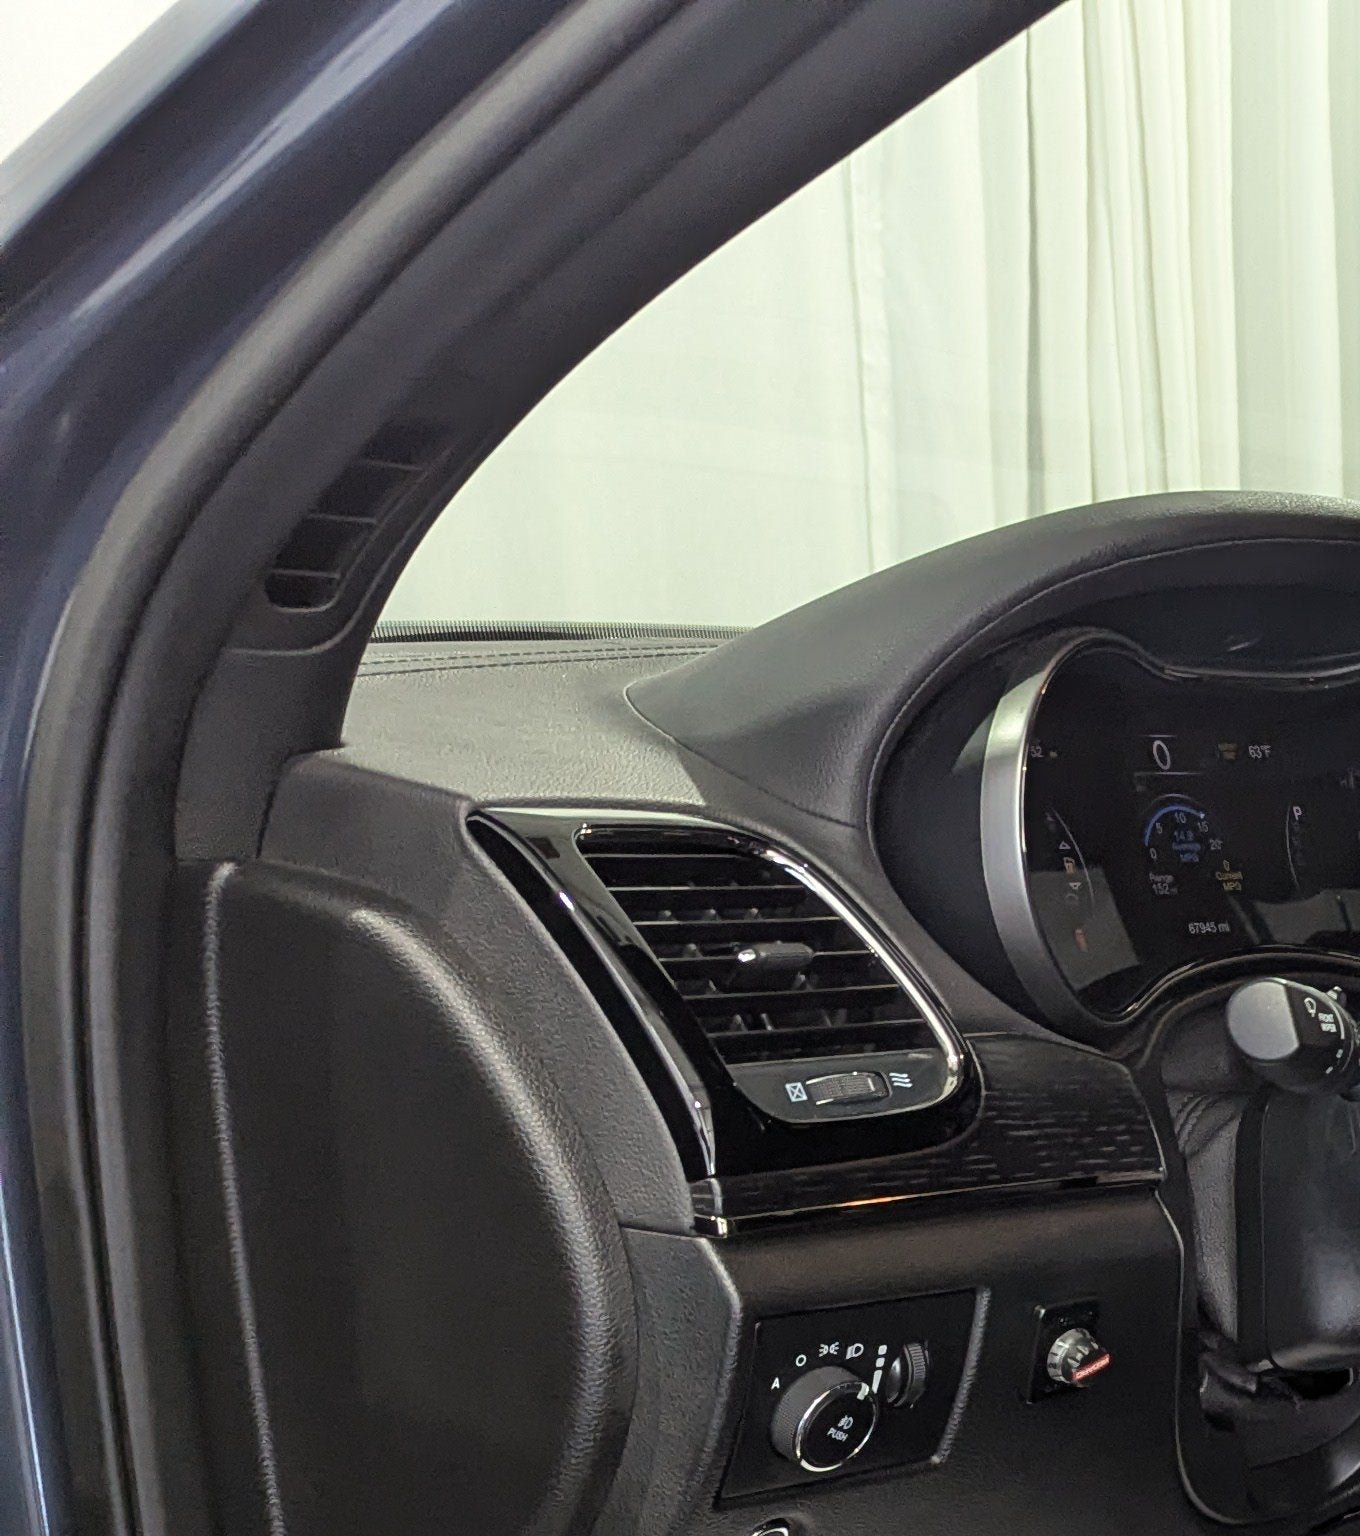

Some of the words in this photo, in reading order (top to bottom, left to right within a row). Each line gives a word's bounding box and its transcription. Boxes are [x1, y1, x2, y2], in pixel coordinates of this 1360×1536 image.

[1152, 739, 1171, 771] 0
[1292, 805, 1304, 821] P
[770, 1377, 780, 1390] A
[827, 1427, 849, 1443] PUSH
